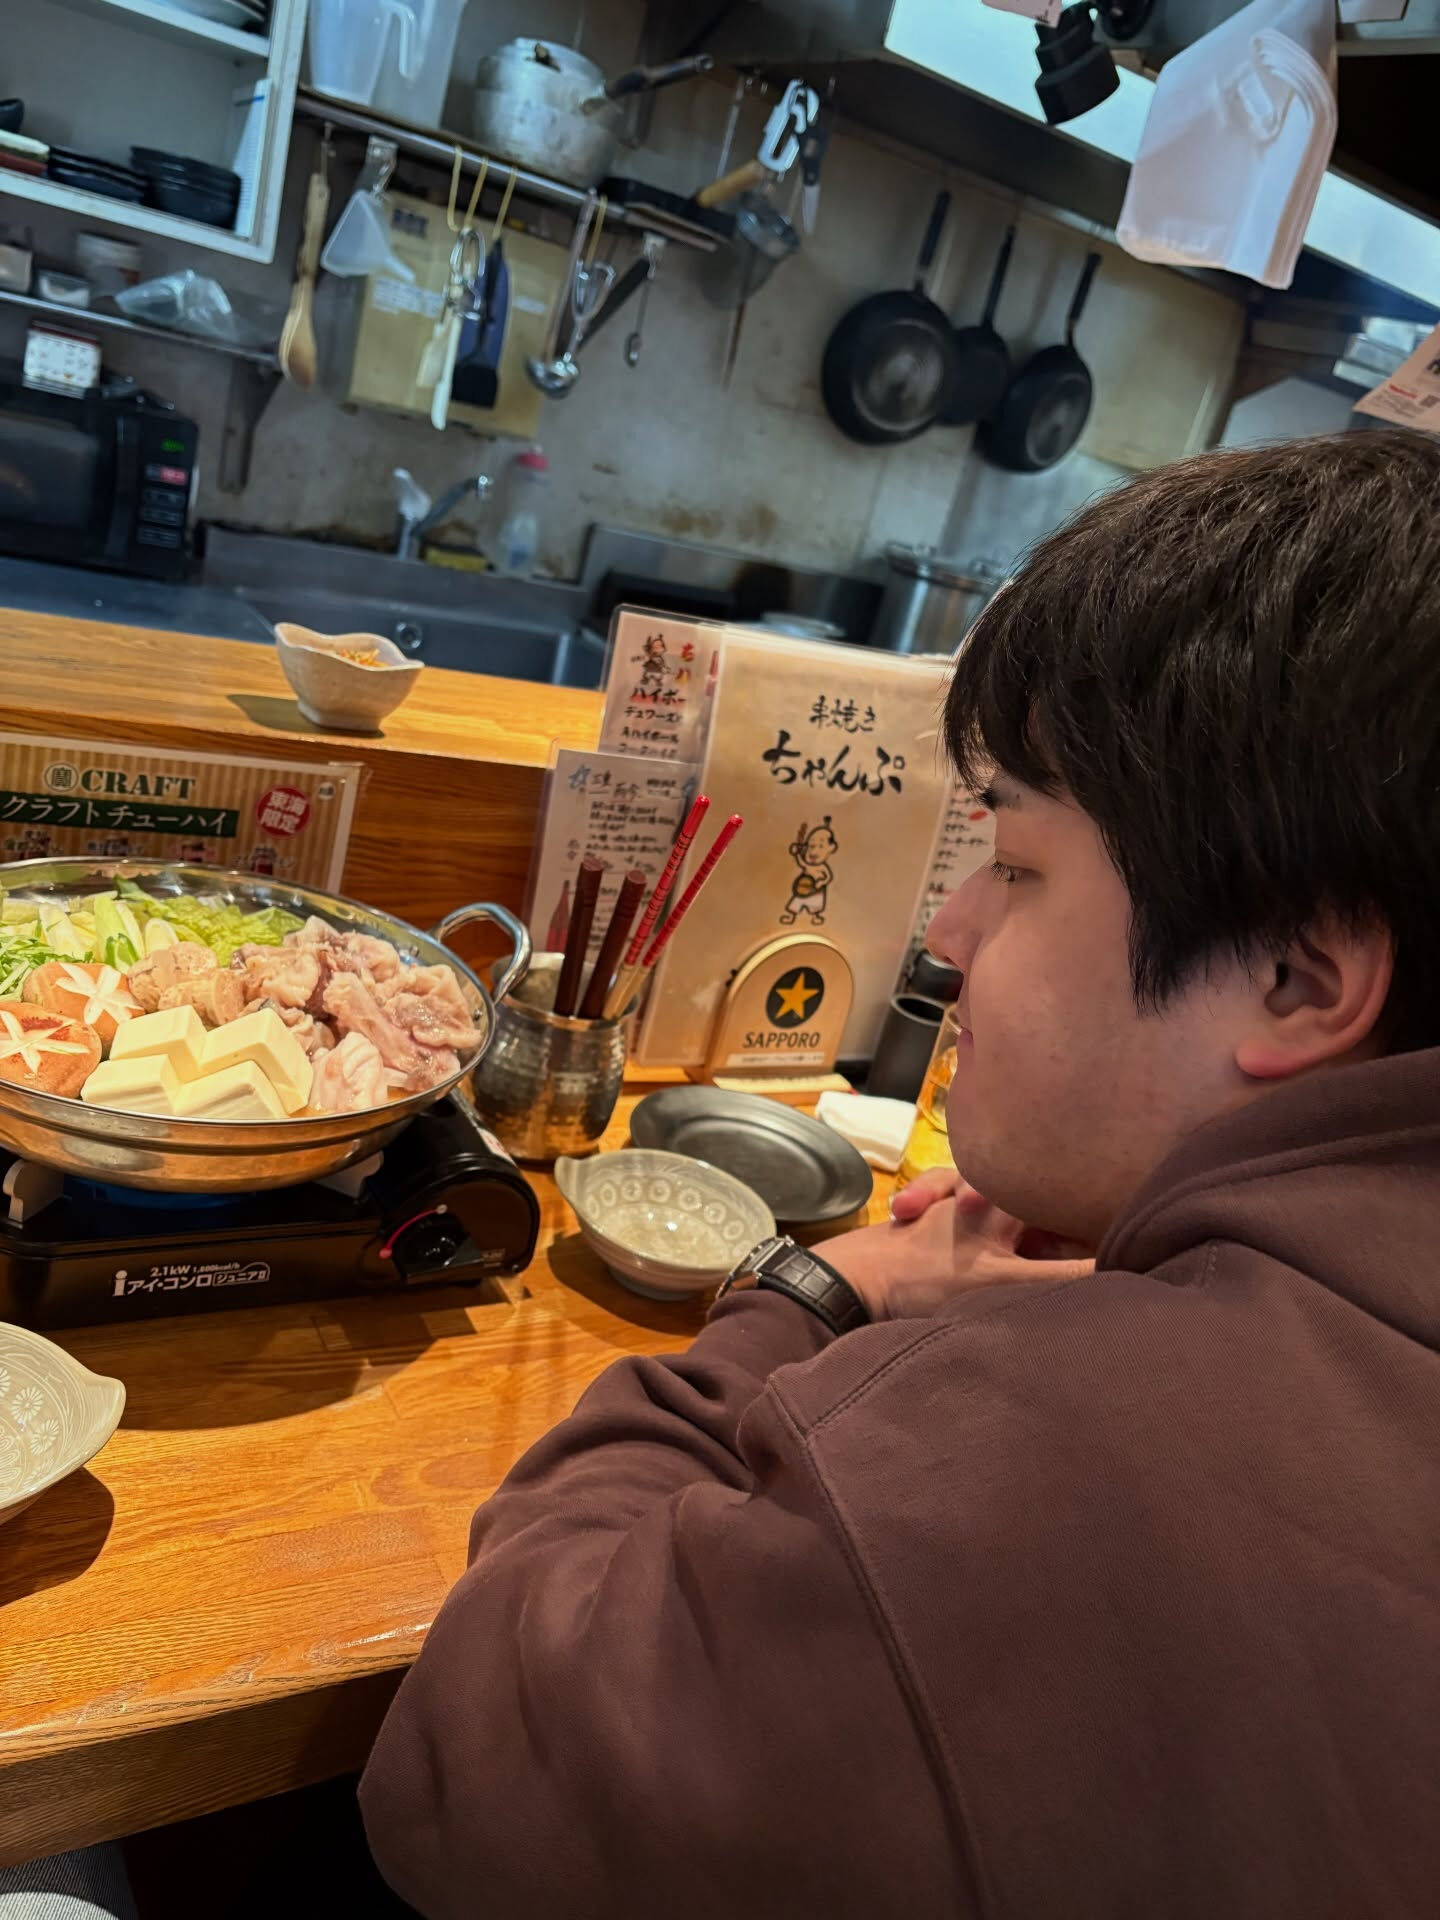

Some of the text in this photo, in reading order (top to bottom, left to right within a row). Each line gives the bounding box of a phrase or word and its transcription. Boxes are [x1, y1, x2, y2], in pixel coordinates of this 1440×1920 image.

[808, 694, 877, 734] 串焼き
[761, 729, 906, 796] ちゃんぷ
[80, 768, 196, 800] CRAFT
[1, 795, 227, 836] クラフトチューハイ
[742, 1031, 821, 1049] SAPPORO
[150, 1264, 191, 1278] 2.1kW
